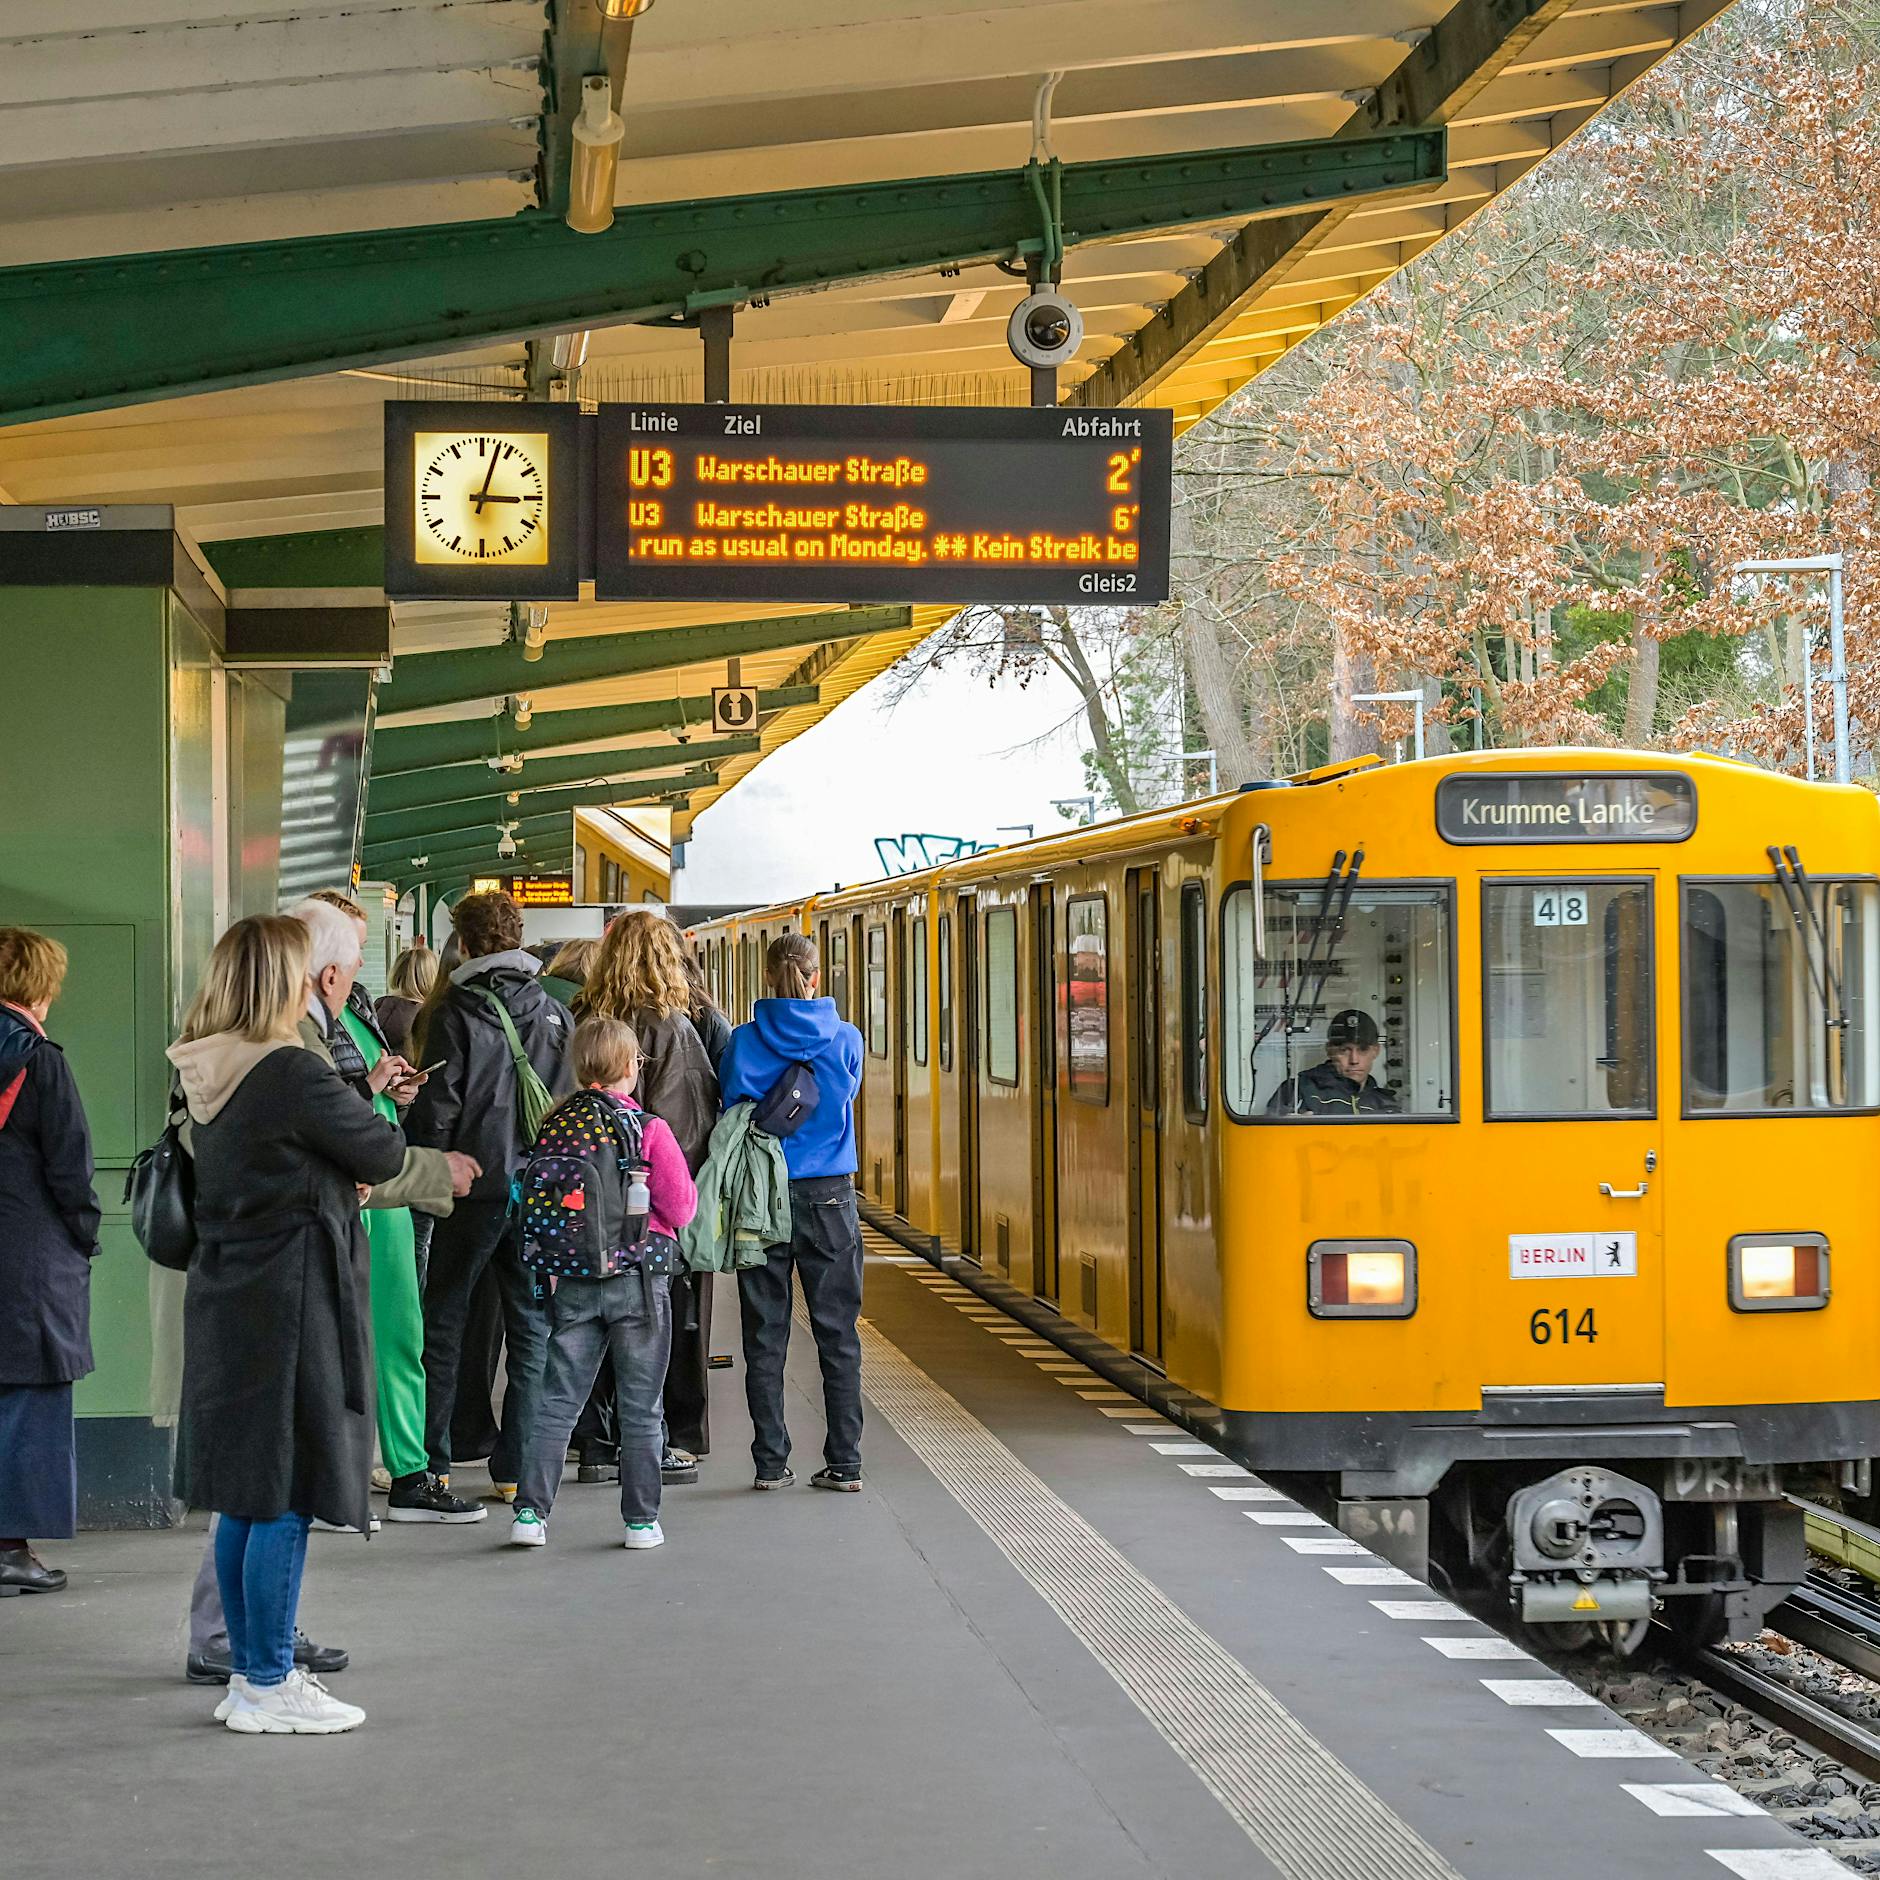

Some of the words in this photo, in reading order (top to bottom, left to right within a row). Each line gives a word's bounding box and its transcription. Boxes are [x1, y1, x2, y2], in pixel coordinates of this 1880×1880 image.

[630, 412, 679, 432] Linie
[723, 415, 762, 435] Ziel
[1061, 417, 1142, 437] Abfahrt
[629, 449, 672, 486] U3
[698, 456, 841, 482] Warschauer
[846, 457, 926, 487] Straße
[629, 502, 661, 527] U3
[697, 503, 840, 528] Warschauer
[845, 504, 925, 533] Straße
[640, 537, 683, 556] run
[689, 538, 717, 557] as
[723, 534, 788, 557] usual
[795, 538, 824, 558] on
[830, 534, 928, 562] Monday.
[973, 535, 1026, 560] Kein
[1030, 536, 1102, 560] Streik
[1107, 536, 1137, 560] be
[1078, 573, 1137, 593] Gleis2
[1462, 798, 1571, 825] Krumme
[1578, 796, 1655, 824] Lanke
[1537, 896, 1583, 922] 48
[1520, 1247, 1586, 1264] BERLIN
[1529, 1307, 1599, 1345] 614
